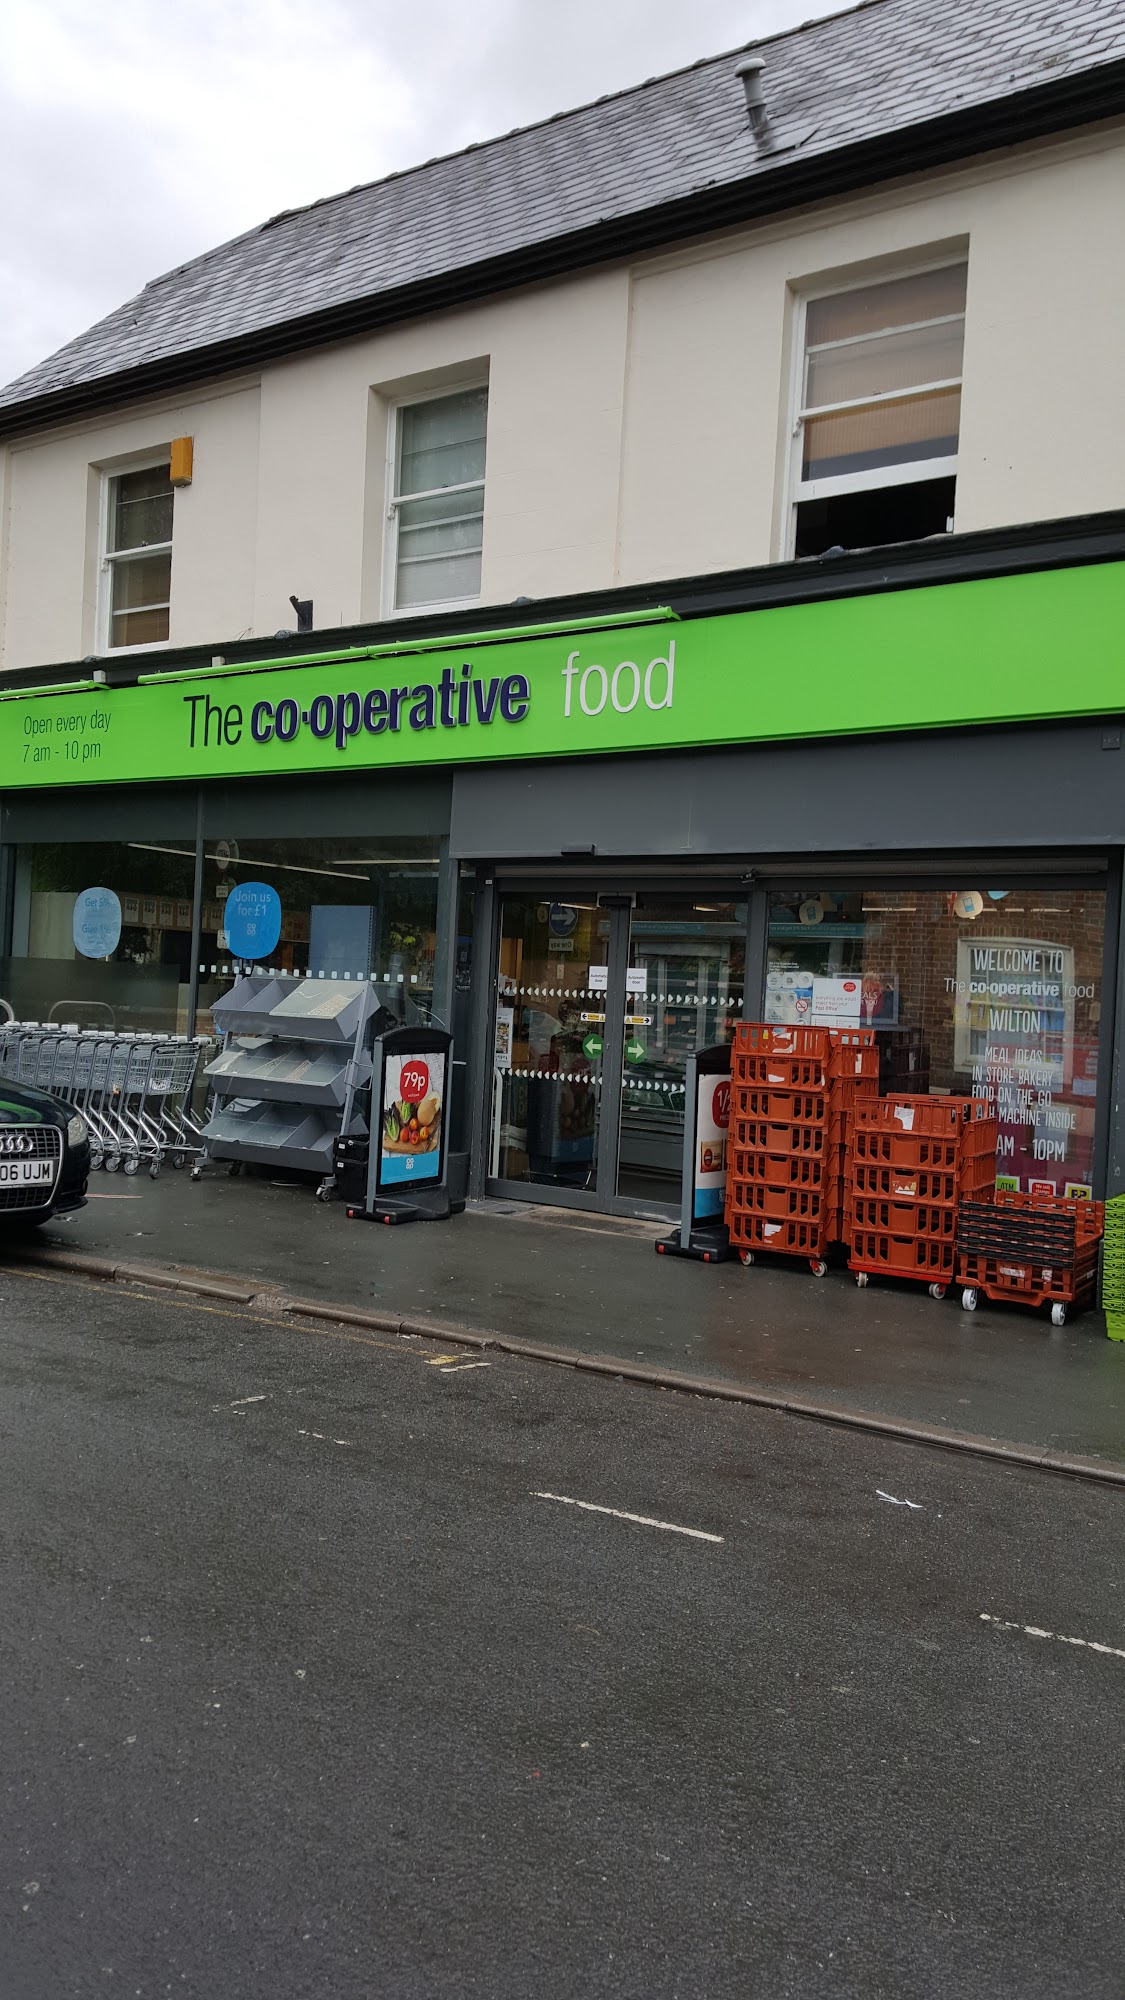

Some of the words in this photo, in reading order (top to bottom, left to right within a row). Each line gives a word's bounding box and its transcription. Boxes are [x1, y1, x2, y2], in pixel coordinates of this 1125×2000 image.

[184, 694, 243, 748] The
[561, 640, 676, 718] food
[24, 716, 52, 738] Open
[56, 714, 87, 734] every
[90, 710, 112, 732] day
[23, 744, 30, 763] 7
[33, 746, 50, 762] am
[64, 741, 78, 760] 10
[82, 743, 102, 763] pm
[84, 898, 98, 908] Get
[236, 890, 257, 902] Join
[260, 894, 272, 903] us
[237, 904, 252, 916] for
[254, 904, 267, 917] £1
[82, 924, 98, 934] Give
[974, 948, 1041, 972] WELCOME
[1048, 950, 1064, 974] TO
[944, 978, 966, 993] The
[1062, 983, 1095, 998] food
[990, 1008, 1041, 1034] WILTON
[984, 1046, 1011, 1064] MEAL
[1014, 1048, 1042, 1065] IDEAS
[403, 1072, 426, 1091] 79p
[972, 1066, 982, 1082] IN
[986, 1066, 1014, 1084] STORE
[1018, 1068, 1054, 1086] BAKERY
[972, 1085, 994, 1102] FOOD
[998, 1087, 1012, 1104] ON
[1016, 1088, 1034, 1106] THE
[1037, 1090, 1052, 1107] GO
[999, 1108, 1041, 1126] MACHINE
[1045, 1110, 1076, 1130] INSIDE
[996, 1134, 1015, 1157] AM
[1032, 1138, 1065, 1162] 10PM
[0, 1164, 18, 1180] 06
[24, 1163, 50, 1180] UJM
